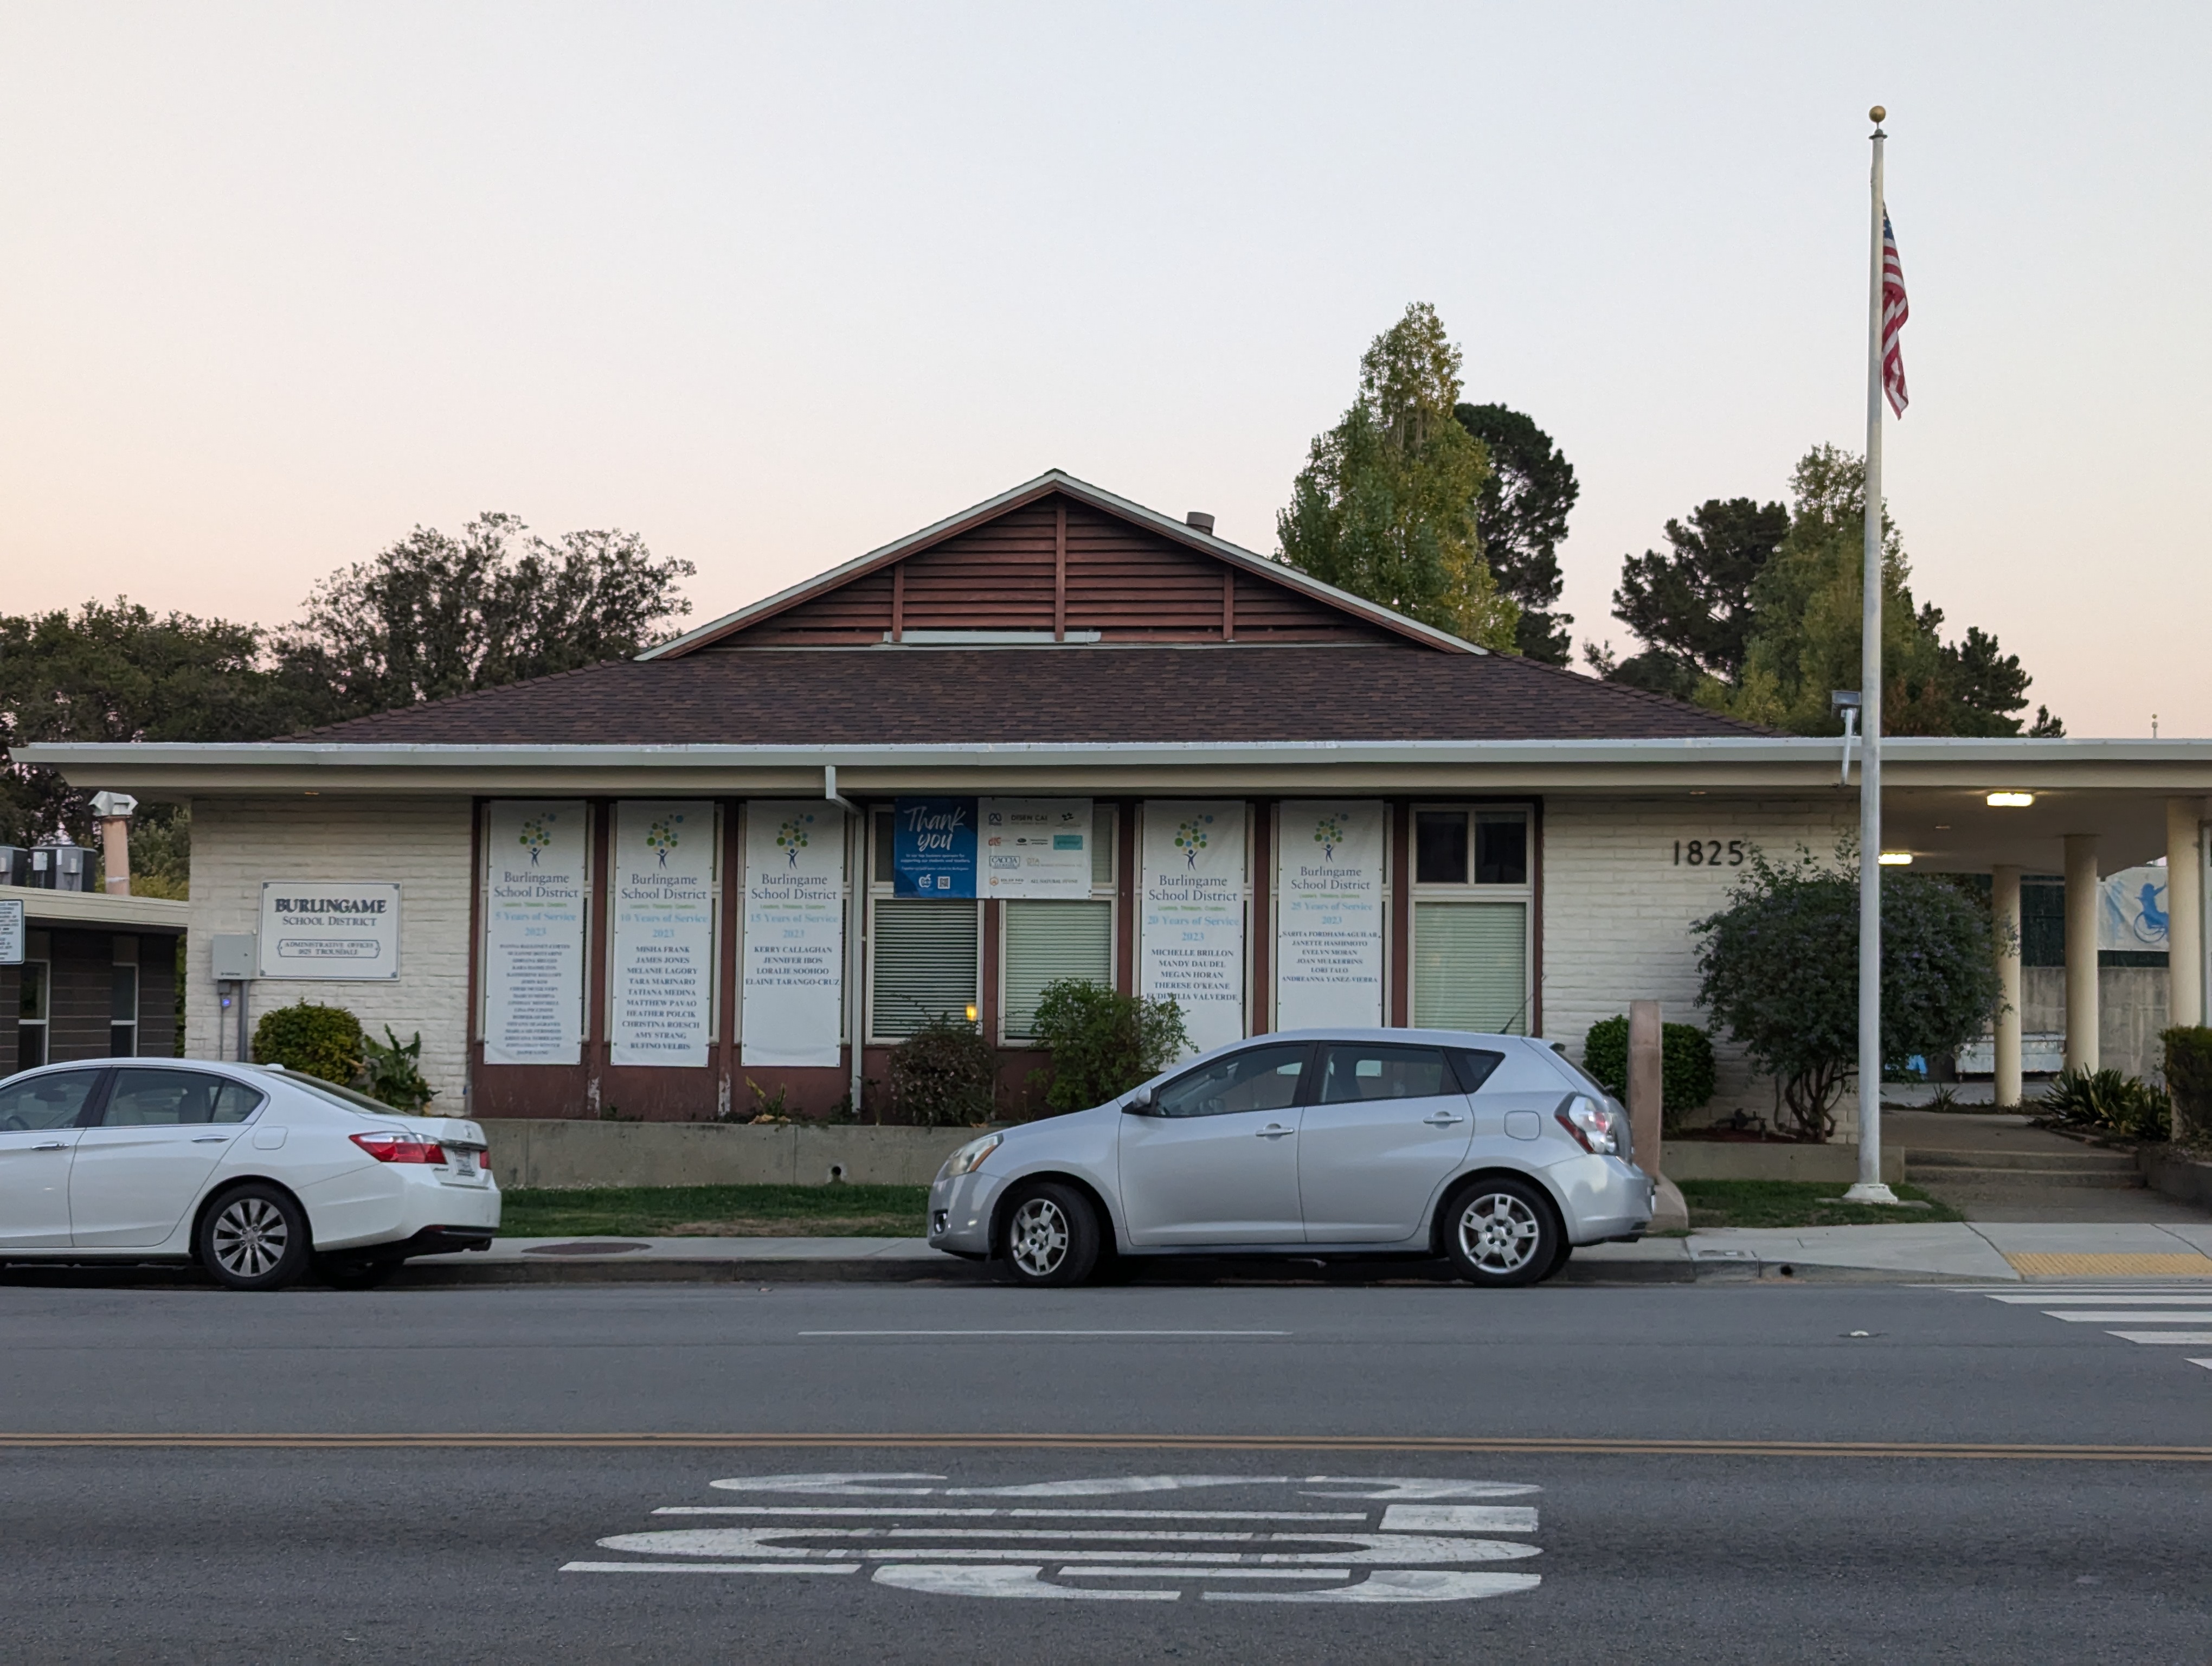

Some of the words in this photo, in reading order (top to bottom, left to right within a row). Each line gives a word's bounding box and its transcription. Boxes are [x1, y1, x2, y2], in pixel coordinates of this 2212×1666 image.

[903, 806, 966, 832] Thank
[917, 832, 953, 852] you
[1674, 840, 1743, 866] 1825
[1301, 866, 1361, 878] Burlingame
[504, 872, 569, 885] Burlingame
[632, 874, 698, 887] Burlingame
[762, 874, 827, 887] Burlingame
[1159, 875, 1227, 888] Burlingame
[1291, 879, 1326, 889] School
[1330, 880, 1370, 889] District
[494, 886, 531, 898] School
[536, 887, 578, 898] District
[621, 888, 659, 899] School
[664, 889, 706, 900] District
[751, 888, 789, 899] School
[794, 889, 837, 900] District
[1149, 889, 1188, 901] School
[1193, 890, 1237, 901] District
[274, 898, 387, 914] BURLINGAME
[1304, 902, 1328, 911] Years
[1331, 902, 1339, 911] of
[283, 917, 324, 925] SCHOOL
[329, 917, 377, 926] DISTRICT
[495, 912, 500, 920] 5
[504, 912, 529, 920] Years
[532, 912, 541, 920] of
[544, 912, 576, 921] Service
[621, 913, 631, 921] 10
[635, 914, 660, 922] Years
[663, 914, 672, 922] of
[675, 914, 708, 922] Service
[750, 914, 760, 922] 15
[764, 914, 790, 922] Years
[793, 914, 802, 922] of
[805, 914, 838, 922] Service
[1148, 916, 1158, 925] 20
[1162, 917, 1189, 925] Years
[1192, 917, 1203, 925] of
[1204, 917, 1239, 925] Service
[525, 927, 546, 936] 2023
[652, 930, 674, 938] 2023
[783, 930, 805, 938] 2023
[1182, 932, 1204, 941] 2023
